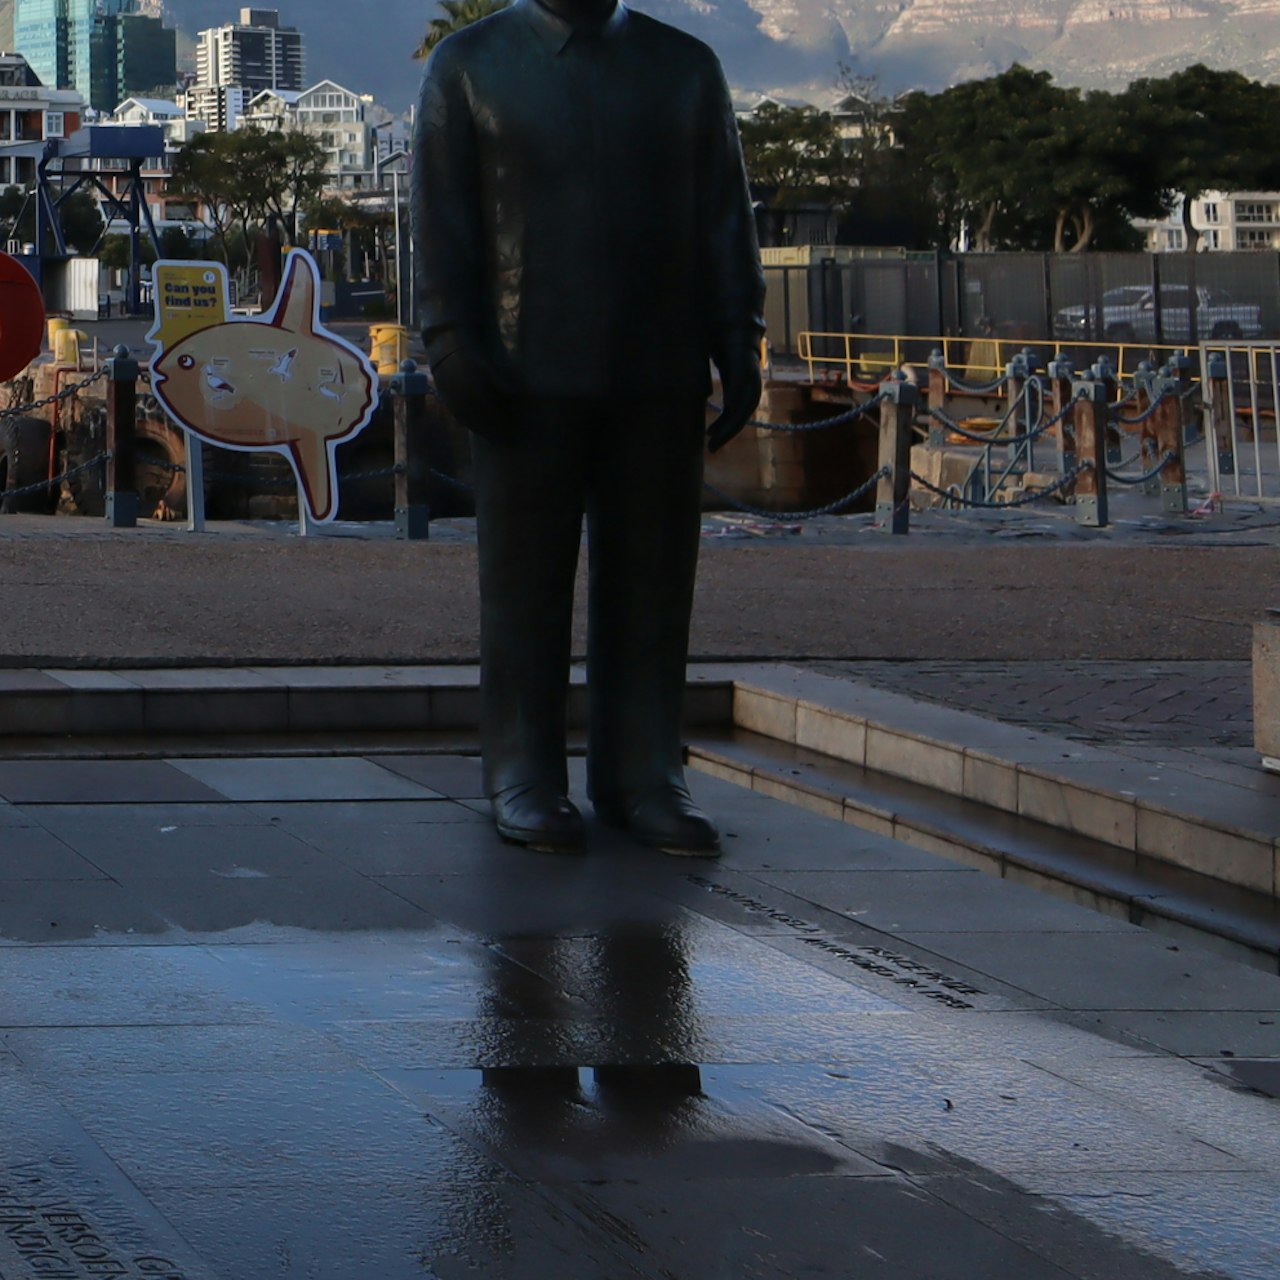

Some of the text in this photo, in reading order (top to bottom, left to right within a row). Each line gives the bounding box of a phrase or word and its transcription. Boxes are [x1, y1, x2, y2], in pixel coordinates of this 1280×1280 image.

[164, 283, 217, 297] Can you
[165, 295, 218, 308] find us?
